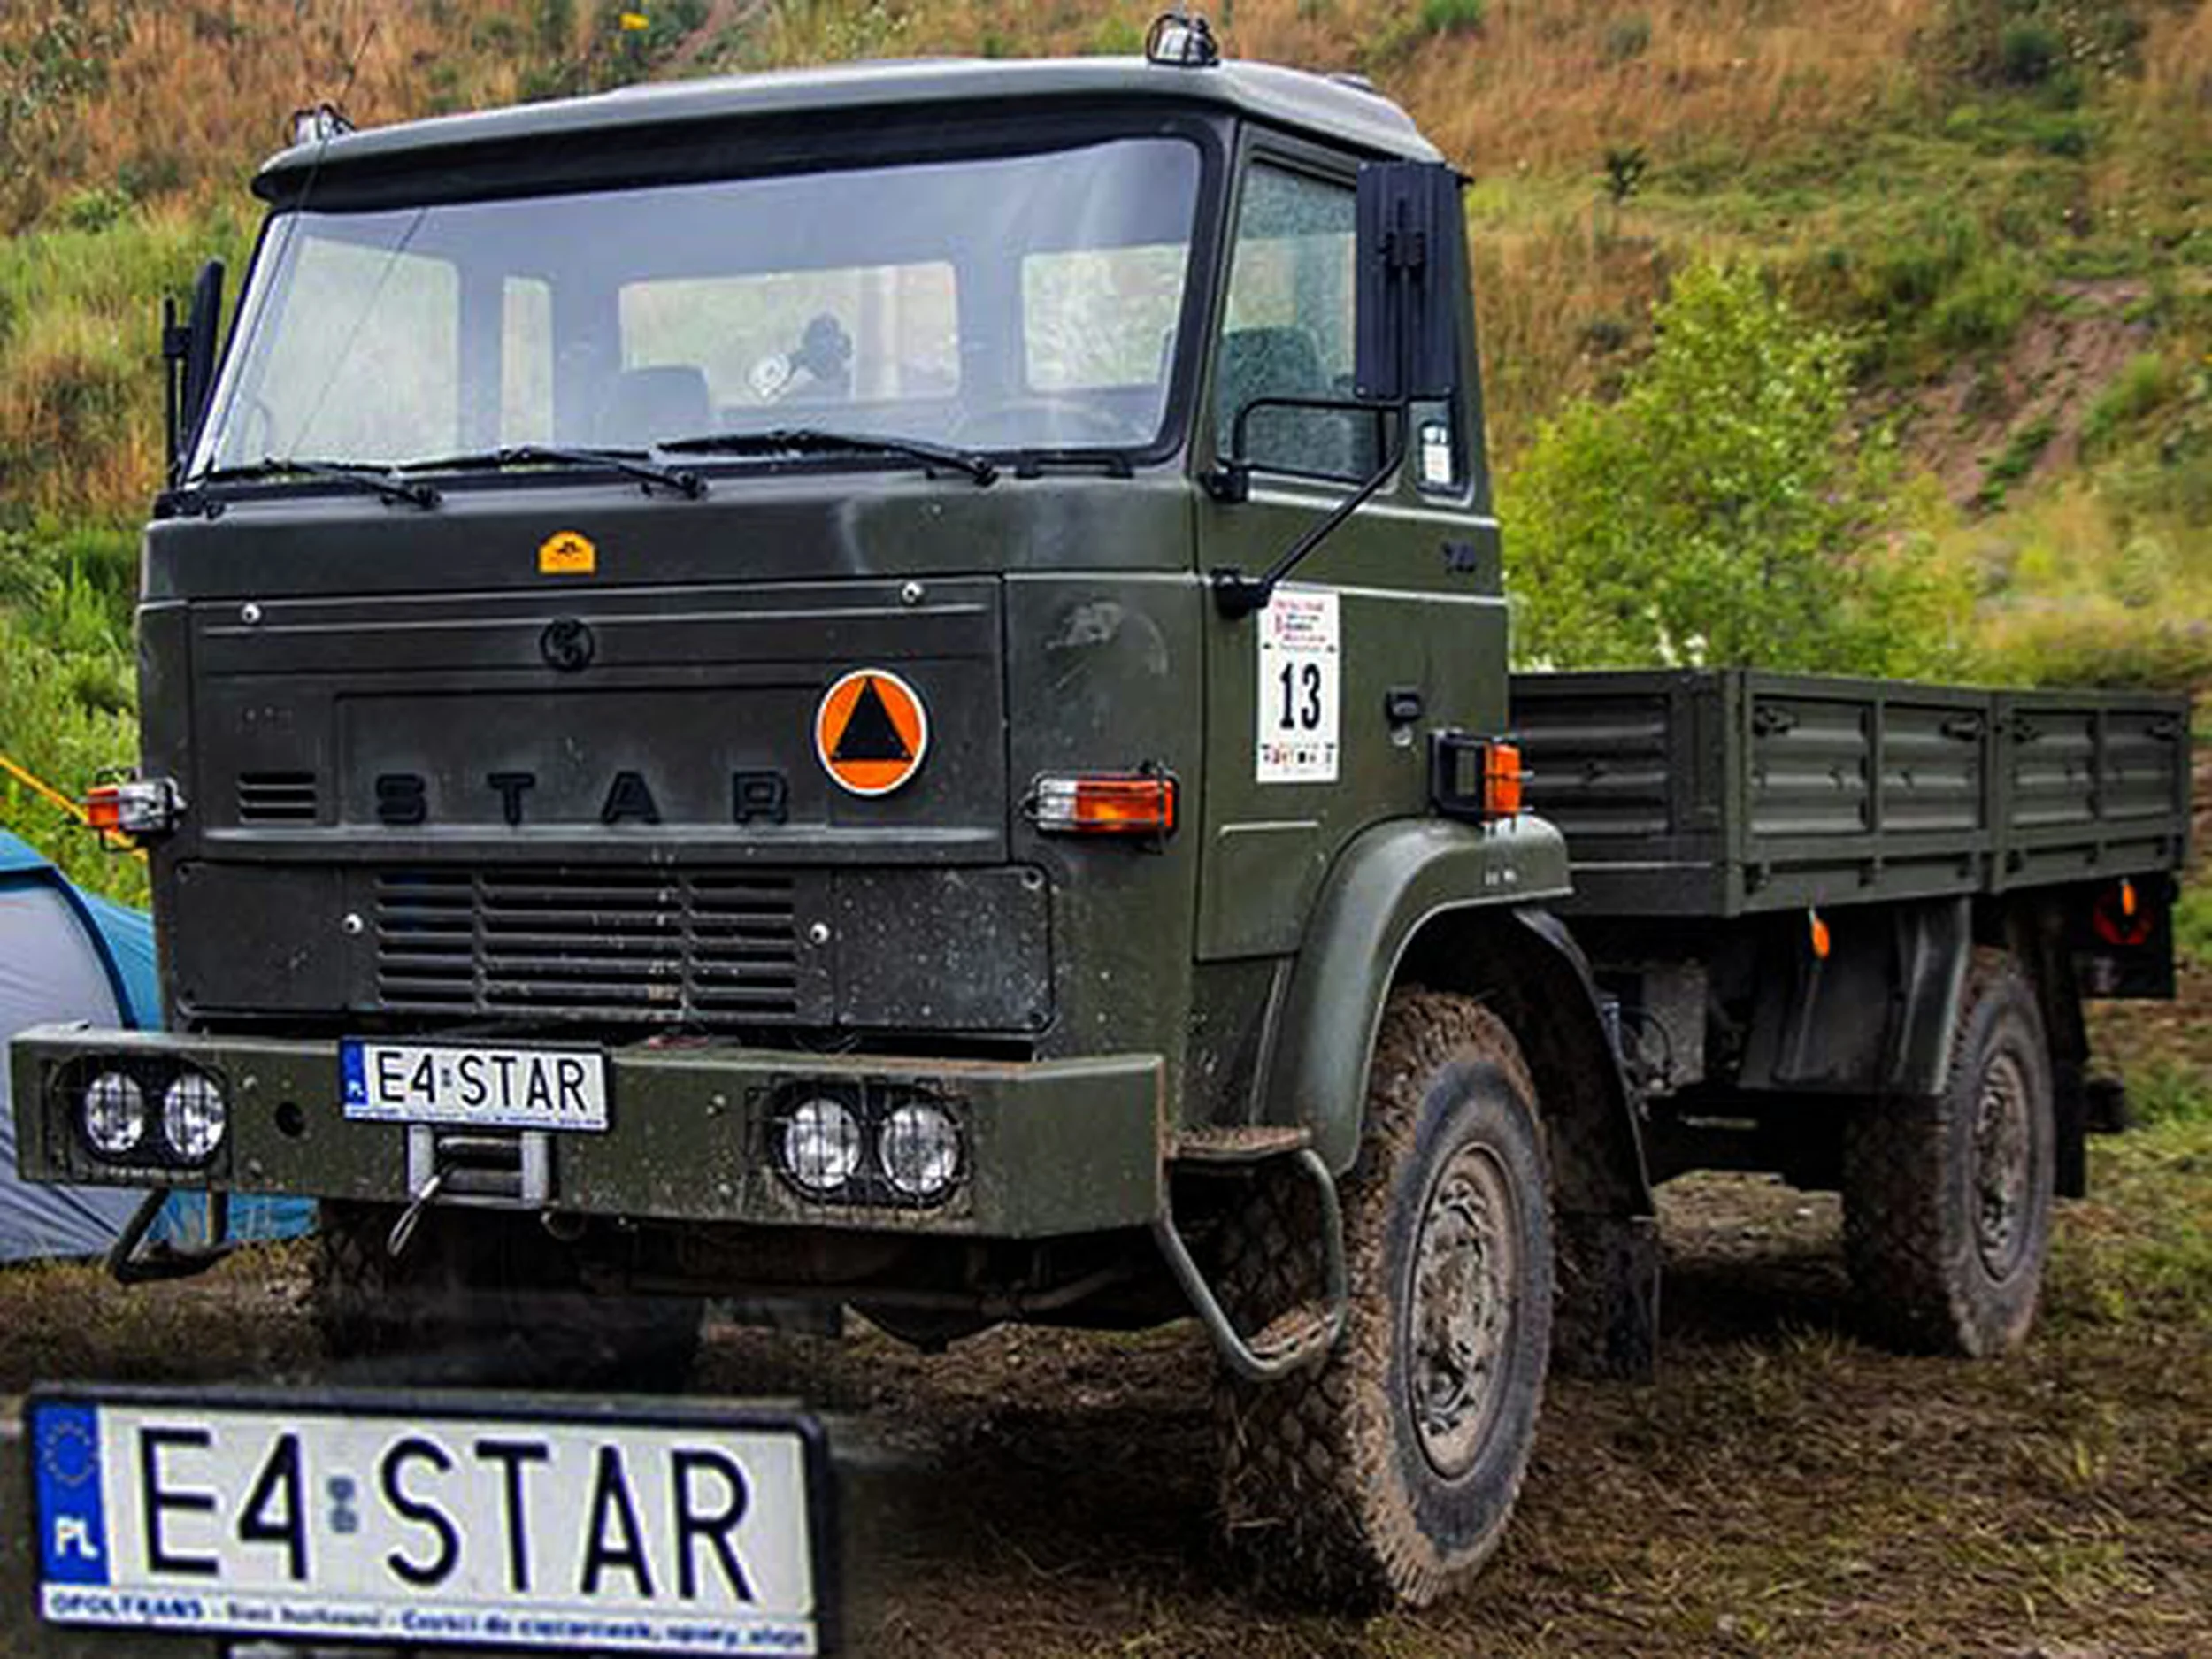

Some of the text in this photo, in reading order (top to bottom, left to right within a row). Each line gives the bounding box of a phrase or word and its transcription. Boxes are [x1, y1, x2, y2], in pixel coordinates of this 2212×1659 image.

[1279, 663, 1321, 731] 13
[375, 771, 789, 826] STAR
[377, 1050, 588, 1112] E4 STAR
[55, 1516, 99, 1558] PL
[138, 1426, 757, 1603] E4 STAR
